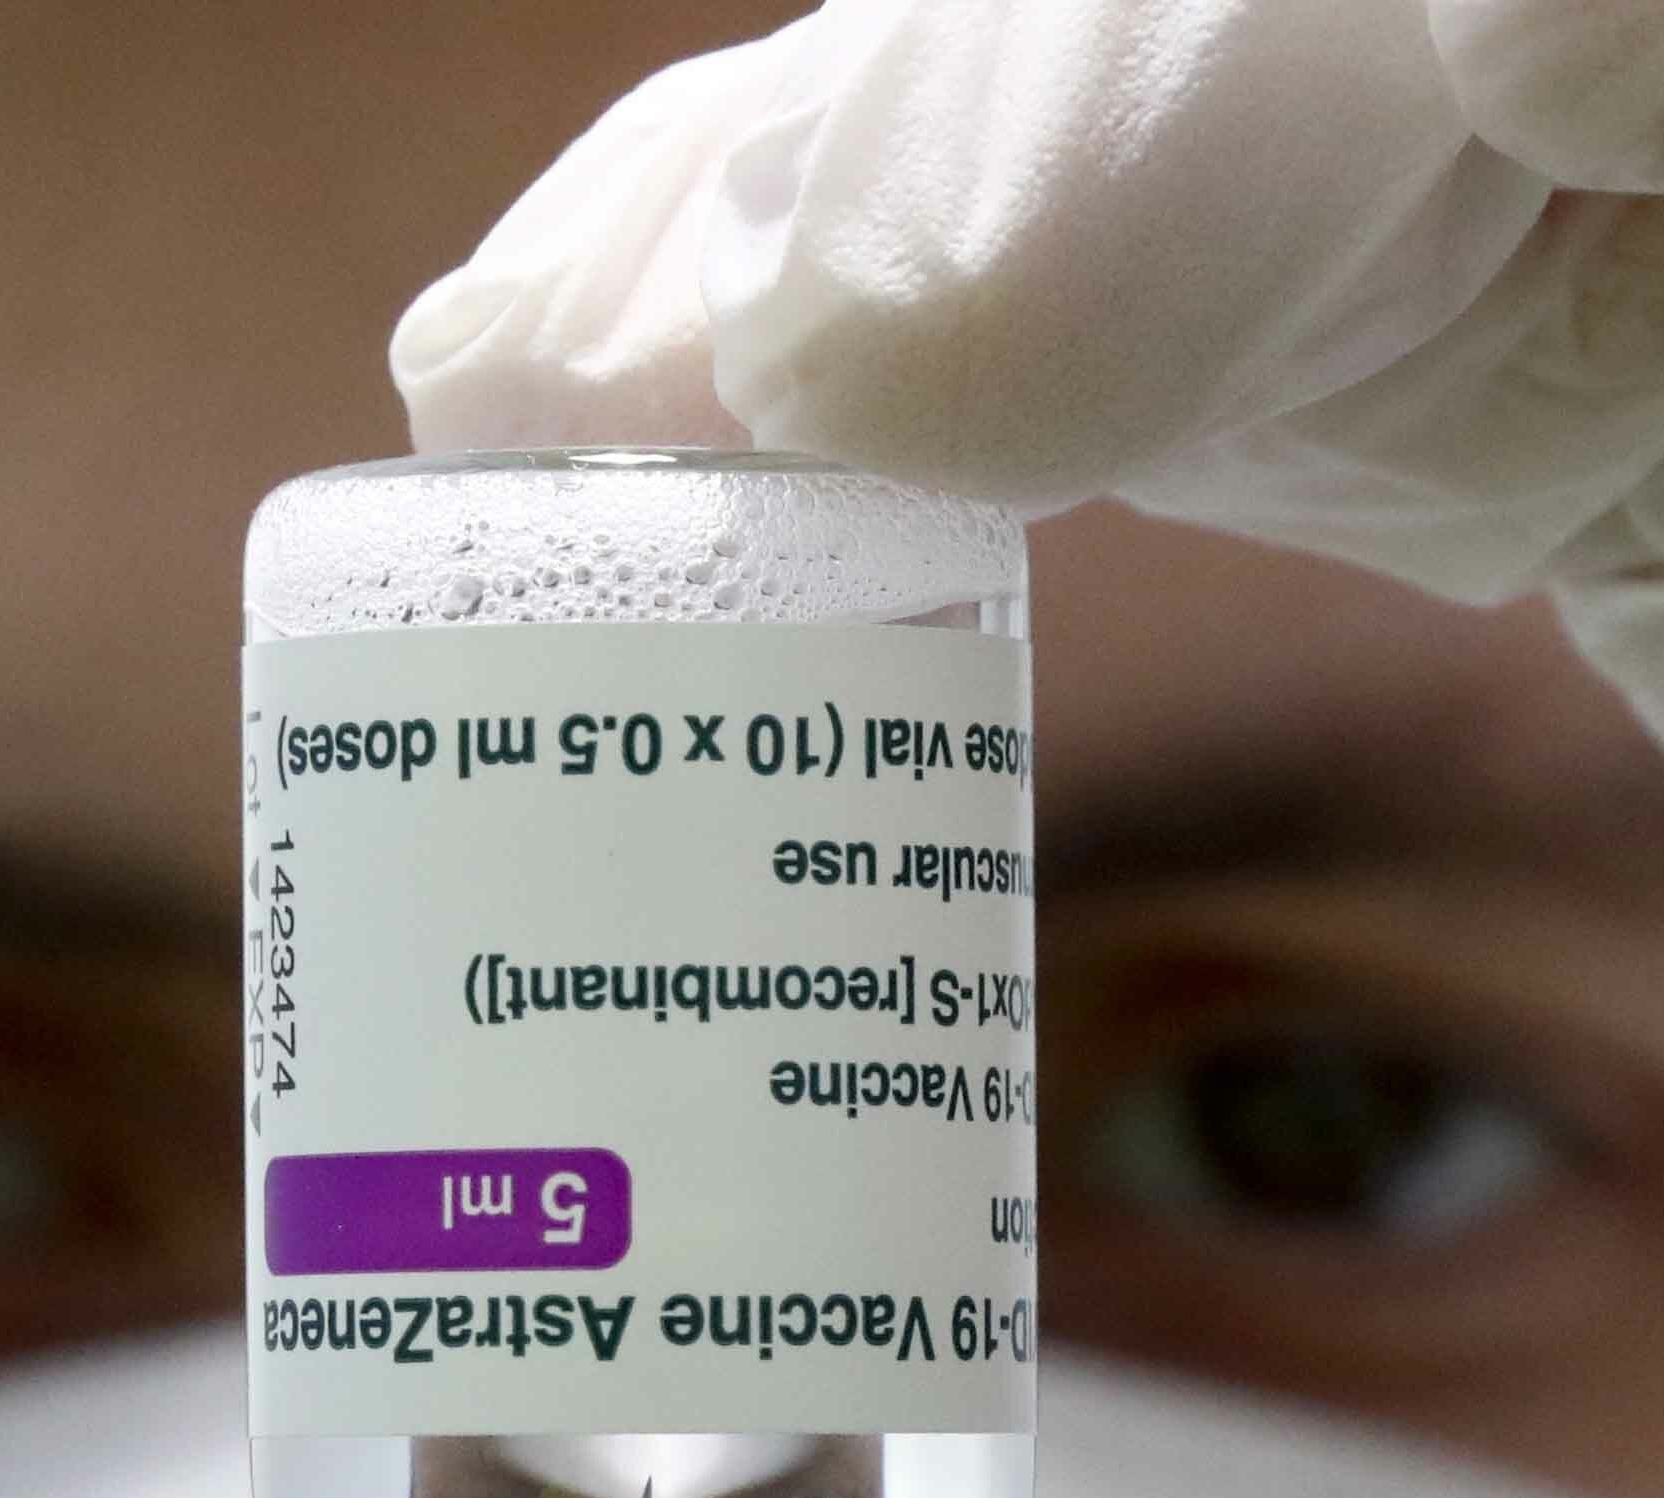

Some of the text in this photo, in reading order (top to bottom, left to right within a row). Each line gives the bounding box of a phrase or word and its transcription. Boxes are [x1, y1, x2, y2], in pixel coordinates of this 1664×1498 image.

[277, 715, 436, 792] doses)
[459, 715, 535, 779] ml
[558, 713, 662, 776] 0.5
[684, 715, 726, 761] x
[746, 702, 845, 779] (10
[867, 717, 955, 780] vial
[773, 839, 876, 885] use
[269, 828, 296, 1098] 1423474
[466, 954, 914, 1026] [recombinant])
[246, 928, 264, 1078] EXP
[769, 1060, 975, 1120] Vaccine
[443, 1172, 587, 1244] 5 ml
[263, 1293, 635, 1363] AstraZeneca
[660, 1293, 936, 1362] Vaccine
